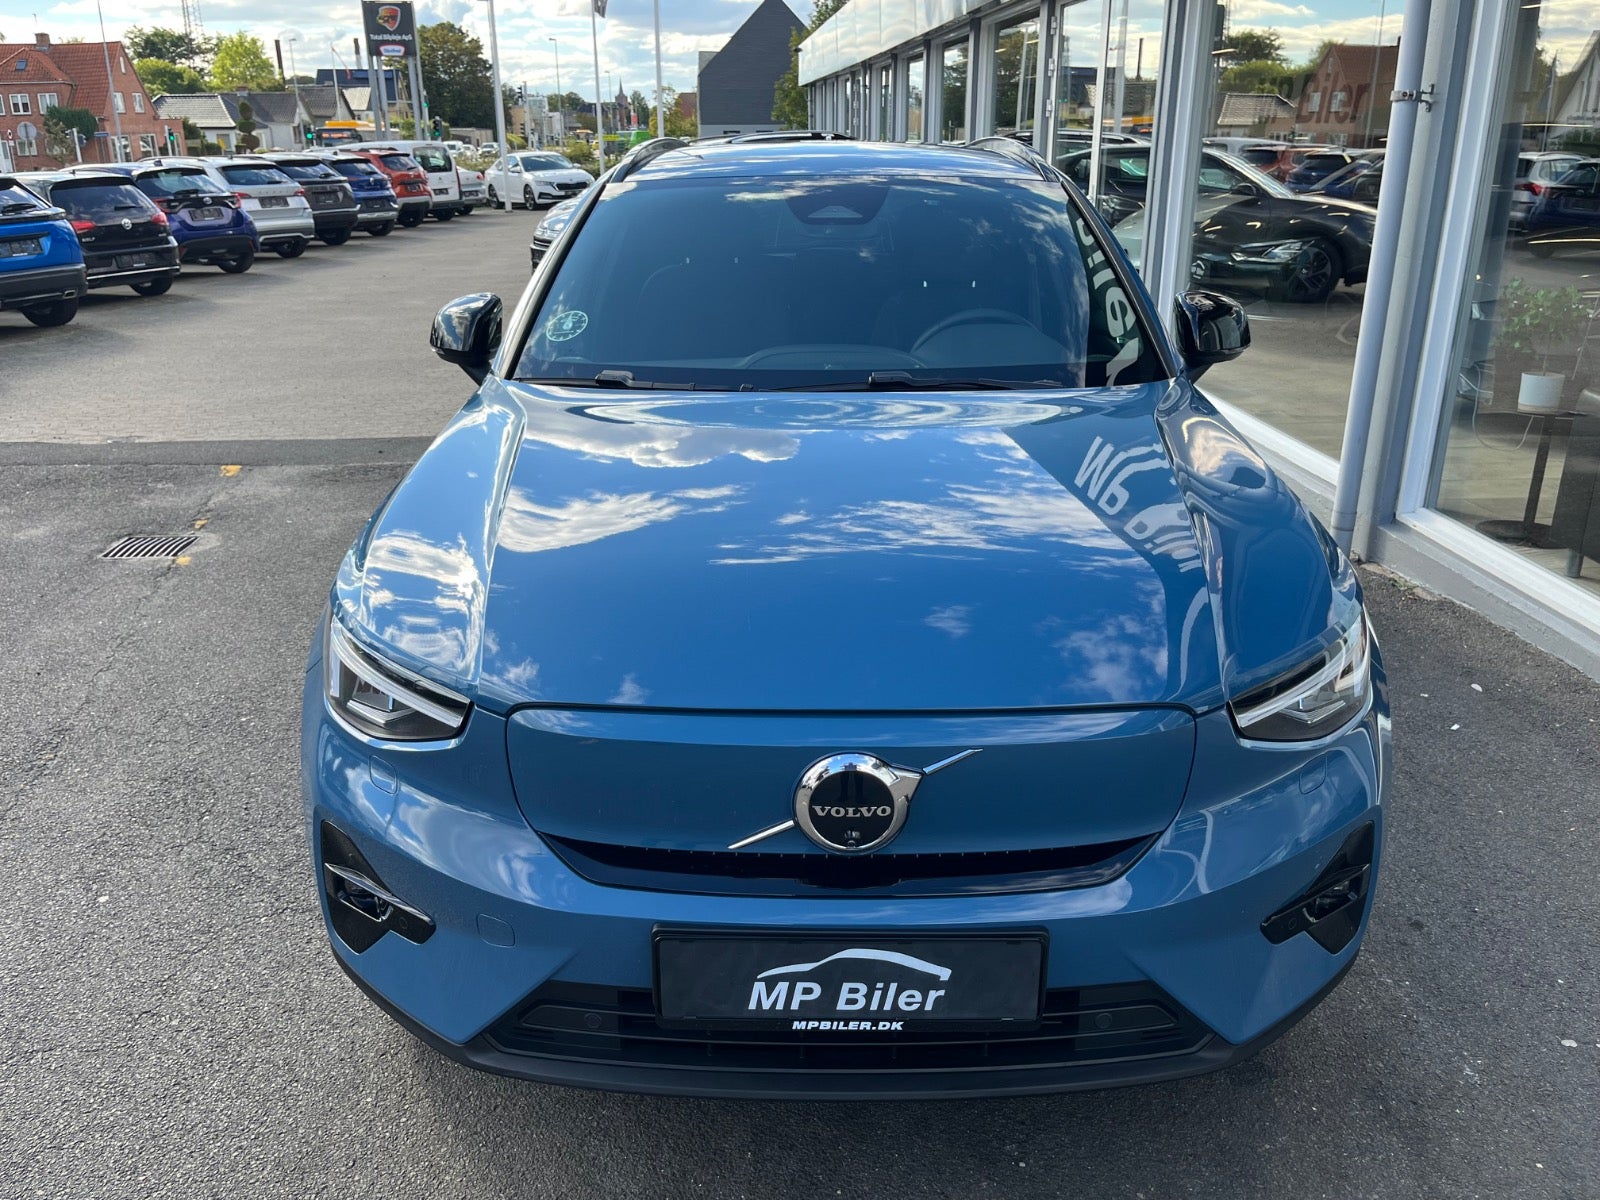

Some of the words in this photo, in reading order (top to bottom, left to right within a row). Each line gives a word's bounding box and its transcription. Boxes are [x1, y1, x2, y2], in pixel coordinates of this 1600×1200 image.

[812, 805, 892, 817] VOLVO
[748, 981, 822, 1011] MP
[836, 982, 946, 1011] Biler
[791, 1020, 905, 1031] MPBILER.DK
